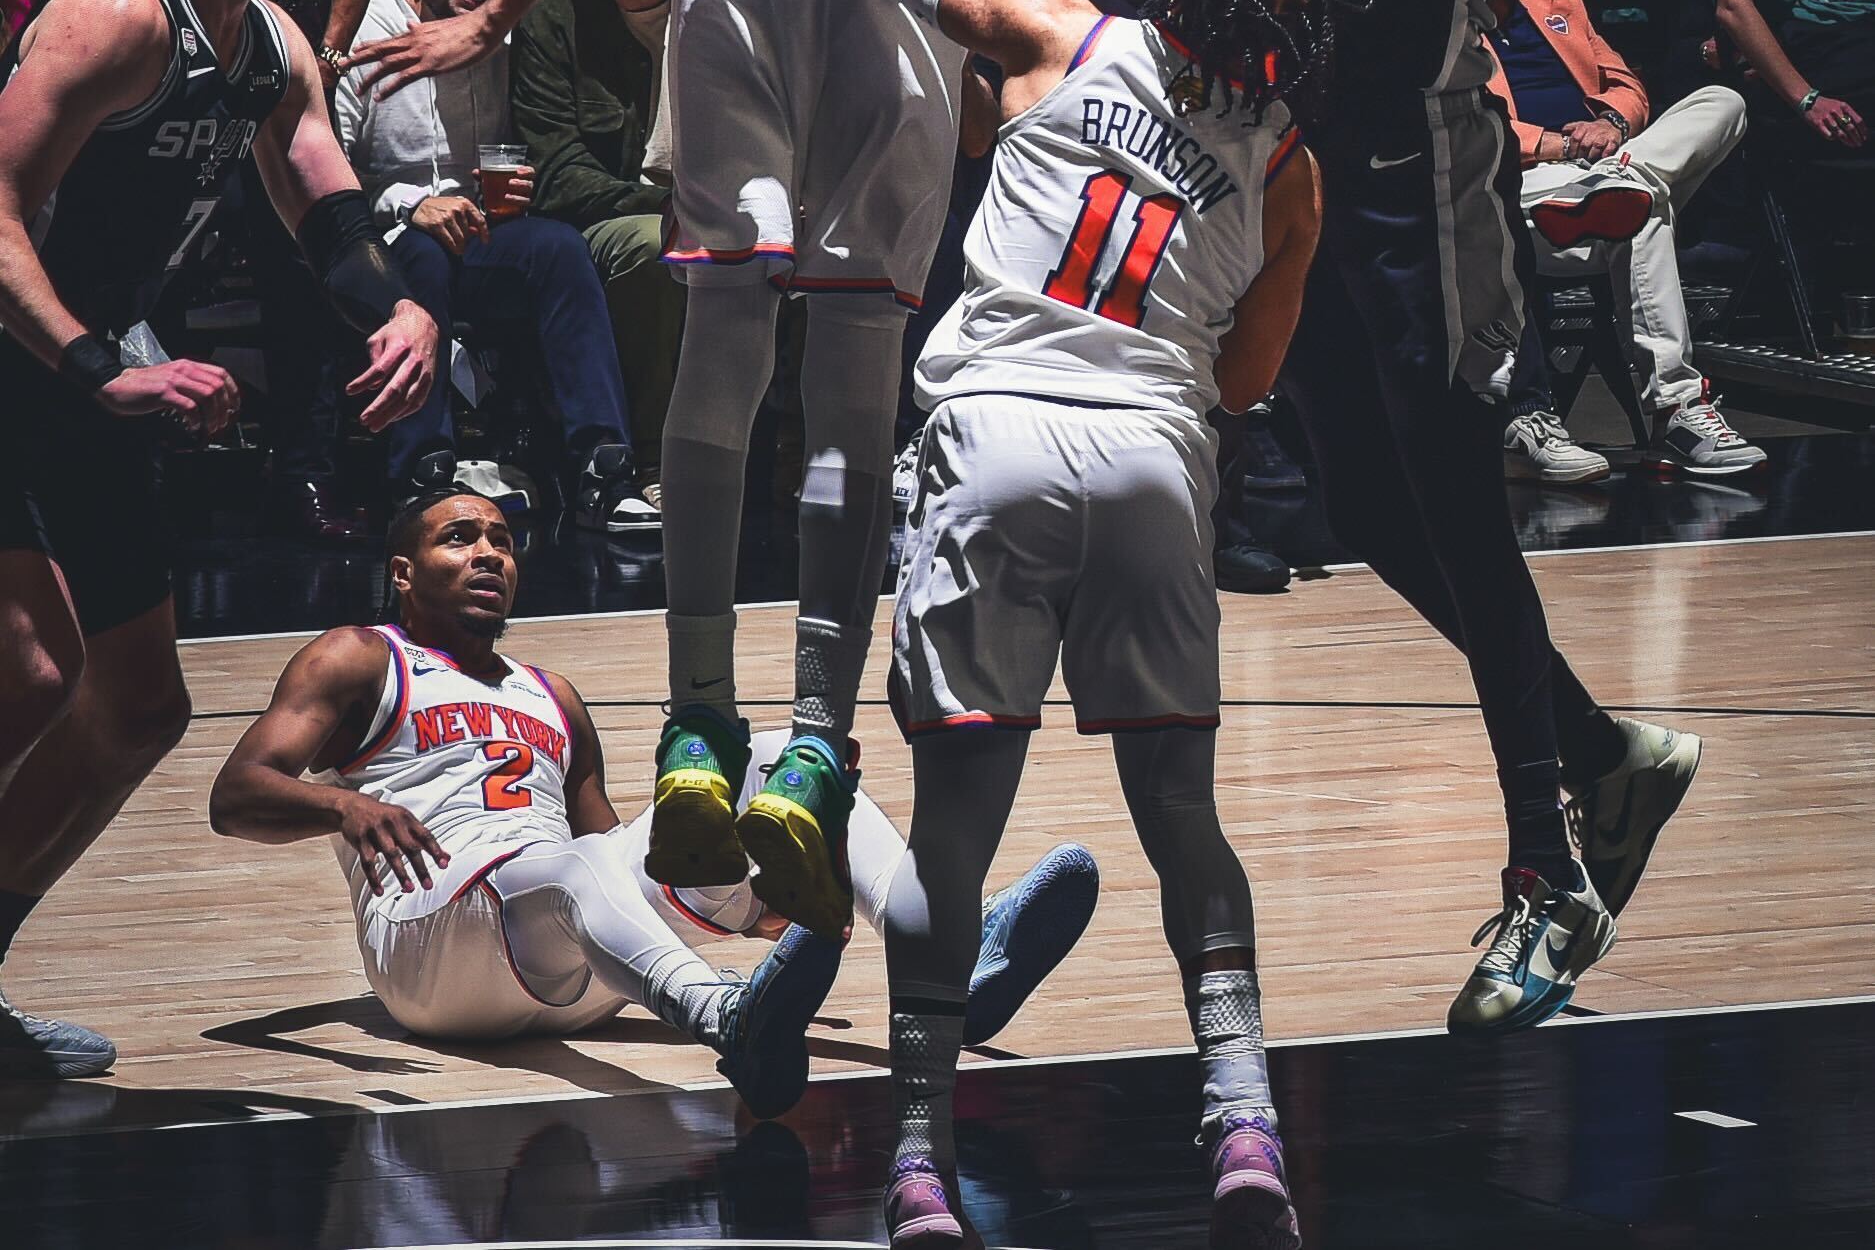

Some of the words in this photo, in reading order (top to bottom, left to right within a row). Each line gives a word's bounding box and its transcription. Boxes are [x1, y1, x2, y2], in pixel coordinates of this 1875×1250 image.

[147, 118, 258, 161] SPUR
[1079, 97, 1238, 216] BRUNSON
[164, 196, 222, 272] 7
[1040, 166, 1187, 330] 11
[411, 701, 493, 755] NEW
[490, 703, 570, 765] YORK
[481, 740, 535, 813] 2
